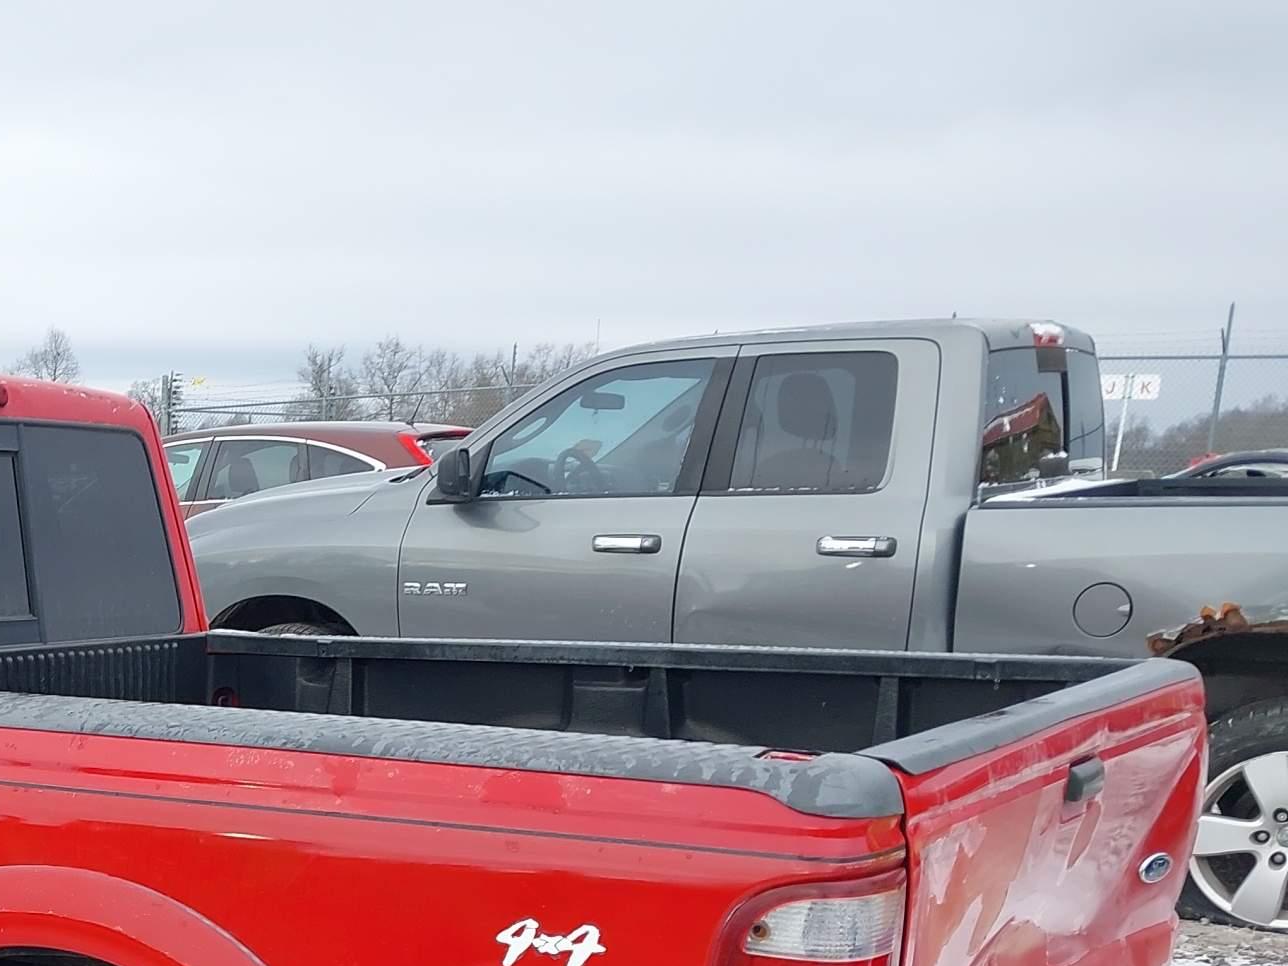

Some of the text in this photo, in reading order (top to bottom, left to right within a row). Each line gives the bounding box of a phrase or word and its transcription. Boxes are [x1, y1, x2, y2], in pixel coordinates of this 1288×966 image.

[1106, 381, 1116, 395] J
[1140, 381, 1152, 395] K
[404, 582, 467, 595] RAM
